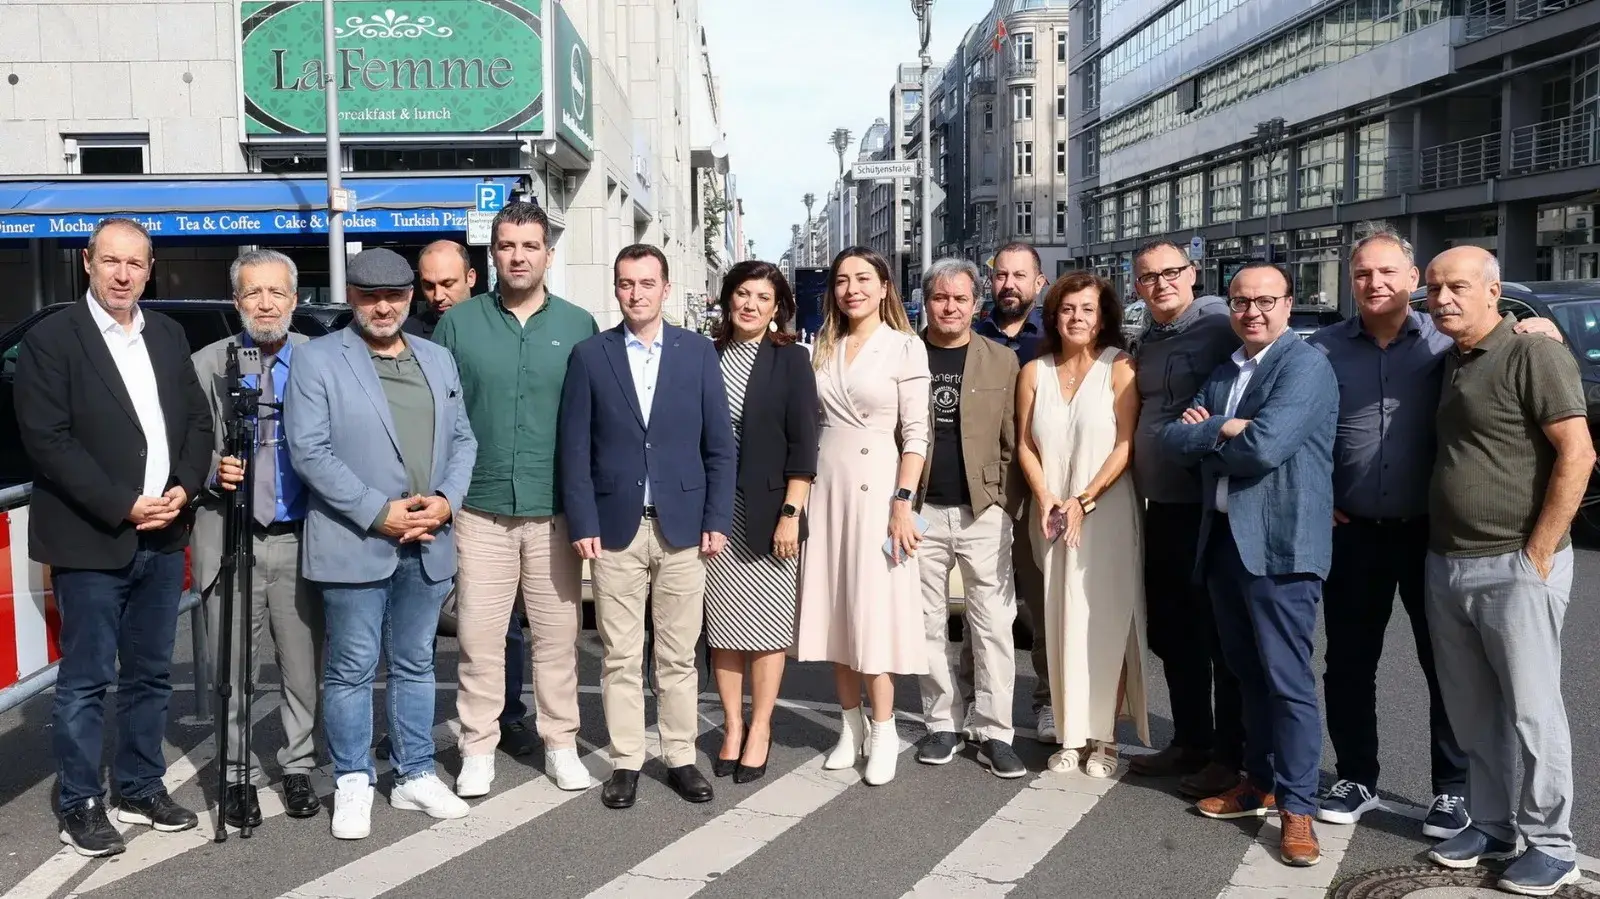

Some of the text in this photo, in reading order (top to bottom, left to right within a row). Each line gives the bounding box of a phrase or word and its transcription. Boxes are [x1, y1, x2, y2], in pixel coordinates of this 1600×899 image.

[271, 46, 515, 92] La Femme
[399, 107, 411, 120] &
[414, 107, 451, 120] lunch
[480, 187, 497, 209] P
[0, 220, 35, 234] inner
[49, 218, 94, 233] Mocha
[175, 216, 200, 231] Tea
[202, 216, 217, 230] &
[219, 215, 261, 230] Coffee
[274, 213, 377, 229] Cake & okies
[390, 212, 467, 227] Turkish Pizz
